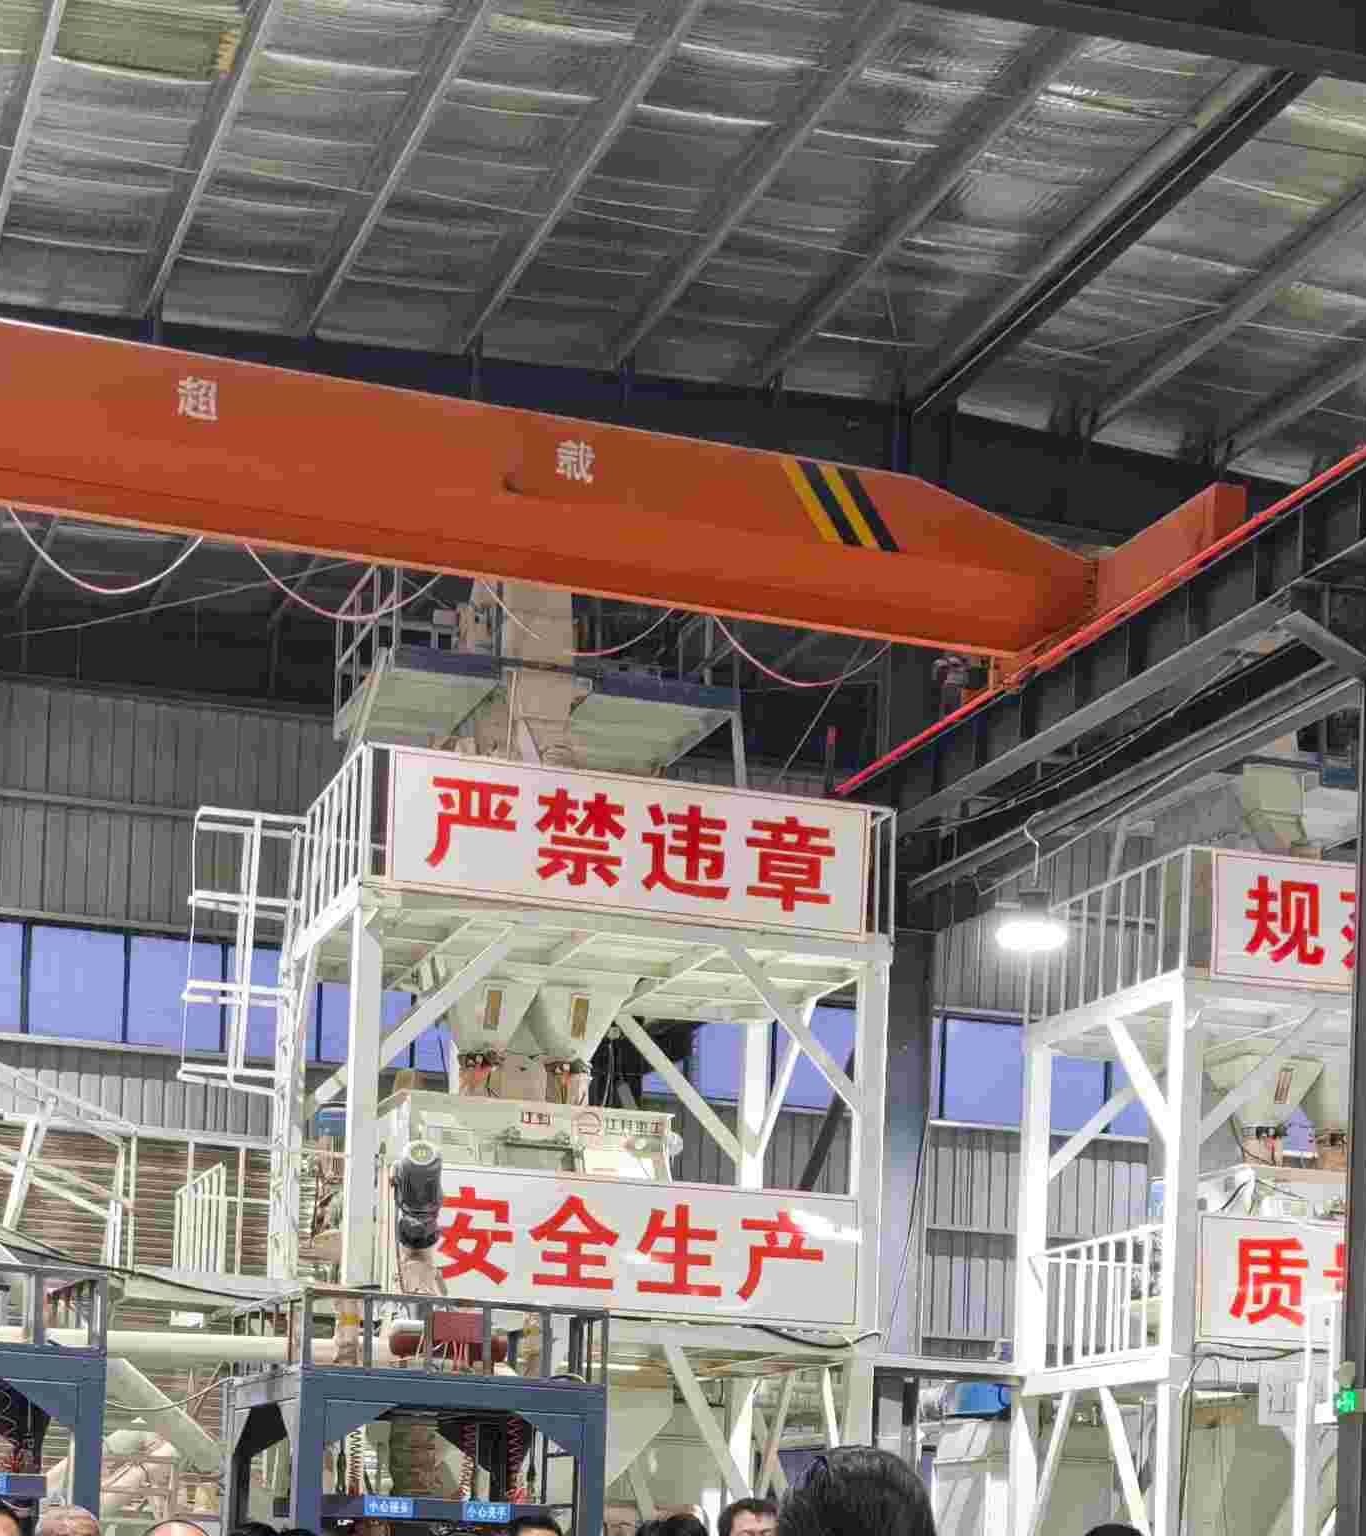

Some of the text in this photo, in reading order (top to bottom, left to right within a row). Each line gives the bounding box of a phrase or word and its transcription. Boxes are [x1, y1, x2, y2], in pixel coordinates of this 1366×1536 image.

[176, 376, 219, 421] 超
[555, 441, 596, 483] 载
[425, 776, 836, 912] 严禁违章
[436, 1186, 825, 1302] 安全生产
